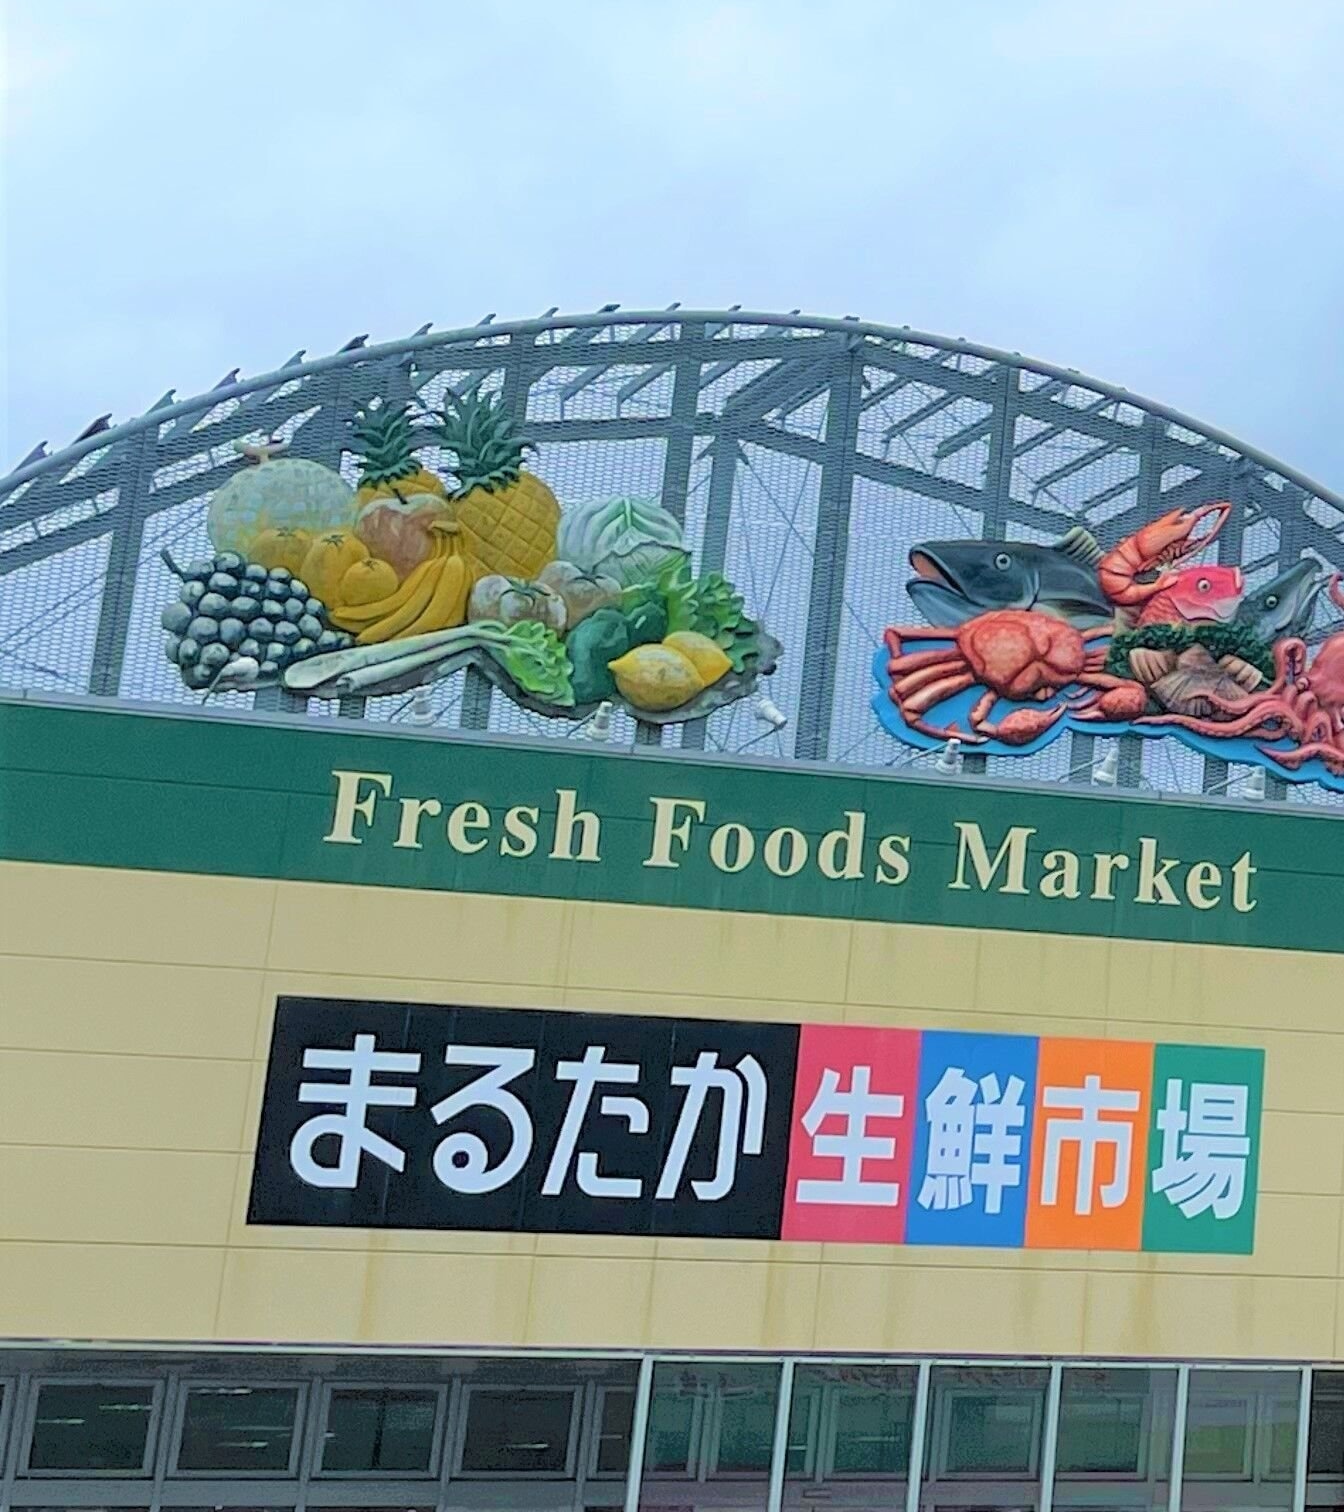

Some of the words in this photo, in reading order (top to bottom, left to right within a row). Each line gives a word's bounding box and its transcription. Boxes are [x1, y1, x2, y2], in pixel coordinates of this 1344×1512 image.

[323, 769, 602, 863] Fresh
[642, 795, 911, 885] Foods
[948, 820, 1258, 913] Market
